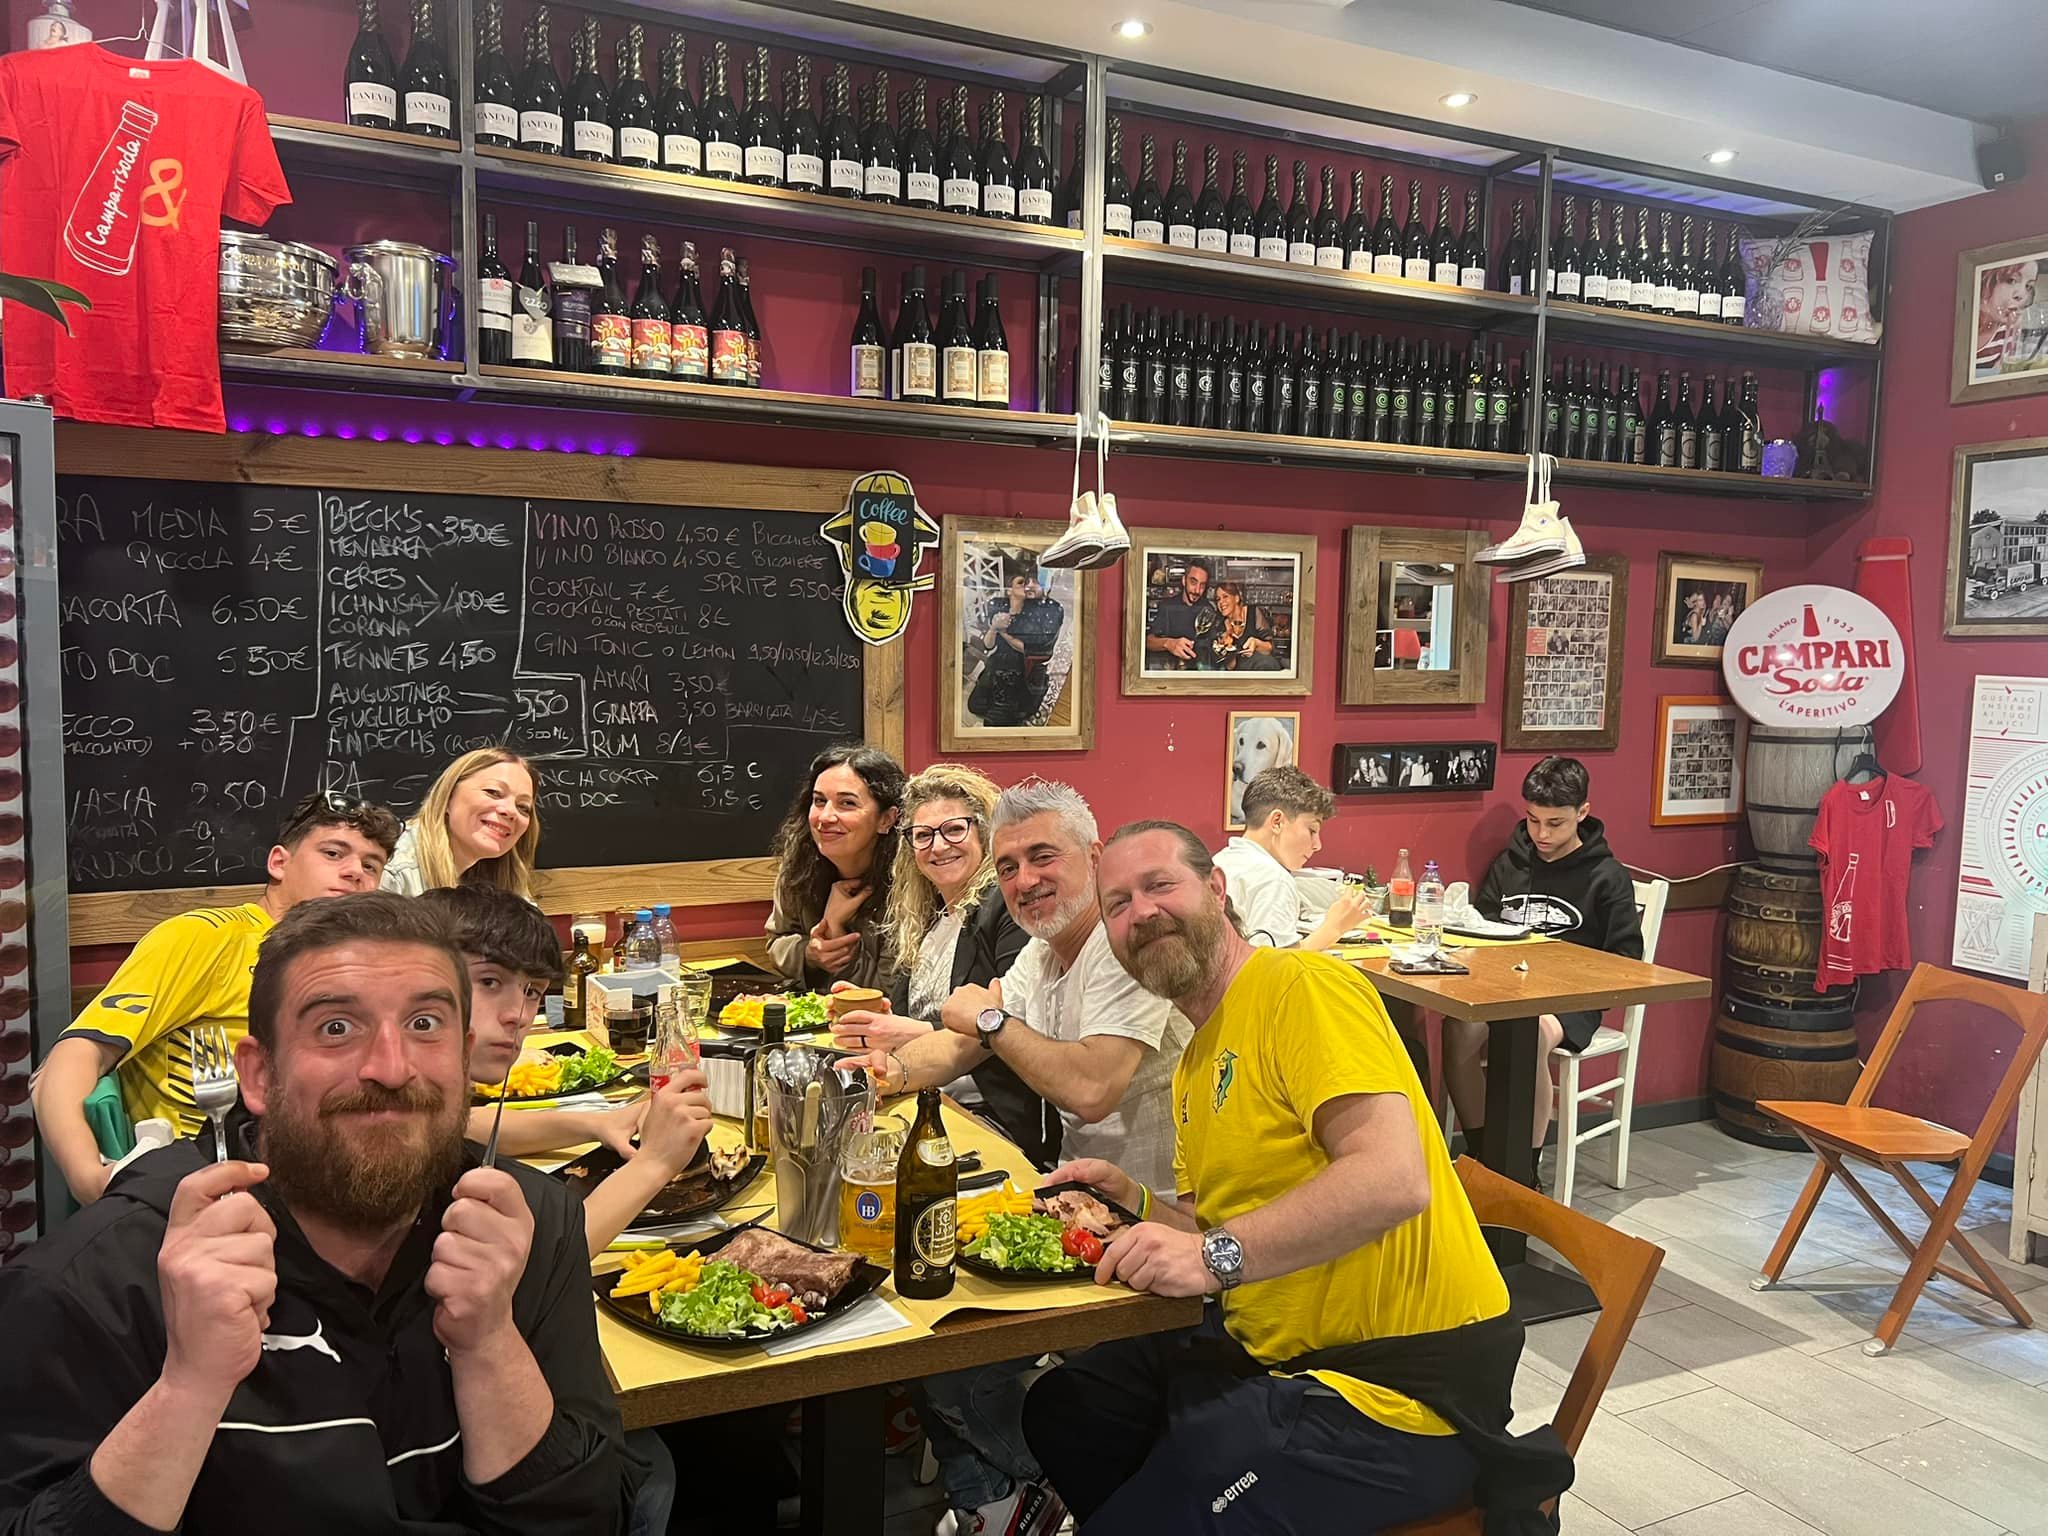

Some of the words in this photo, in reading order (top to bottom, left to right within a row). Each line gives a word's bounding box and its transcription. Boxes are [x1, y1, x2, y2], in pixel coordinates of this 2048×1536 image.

[84, 138, 141, 246] Camparisoda
[132, 502, 228, 541] MEDIA
[534, 510, 598, 541] VINO
[860, 497, 910, 526] Coffee
[126, 540, 233, 574] PICCOLA
[536, 543, 593, 570] VINO
[604, 541, 667, 566] BIANCO
[327, 560, 406, 591] CERES
[529, 576, 621, 601] COCKTAIL
[699, 572, 777, 598] SPRITZ
[331, 591, 426, 616] ICHNUSA
[531, 596, 622, 619] COCKTAIL
[626, 603, 688, 622] PESTATI
[605, 618, 626, 630] CON
[1767, 617, 1798, 640] MILANO
[1825, 615, 1855, 634] 1932
[534, 632, 577, 657] GIN
[584, 633, 653, 658] TONIC
[682, 641, 736, 661] LEMON
[1737, 639, 1892, 677] CAMPARI
[108, 648, 175, 683] DOC
[593, 664, 650, 694] AMARI
[329, 680, 459, 706] AUGUSTINER
[1764, 667, 1865, 695] Soda
[327, 705, 453, 730] GUGLIELMO
[592, 699, 659, 726] GRAPPA
[1778, 697, 1857, 719] L'APERITIVO
[328, 726, 436, 757] ANDECHS
[590, 729, 640, 759] RUM
[580, 791, 628, 809] DOC
[862, 1205, 875, 1217] HB
[1224, 1470, 1258, 1501] errea
